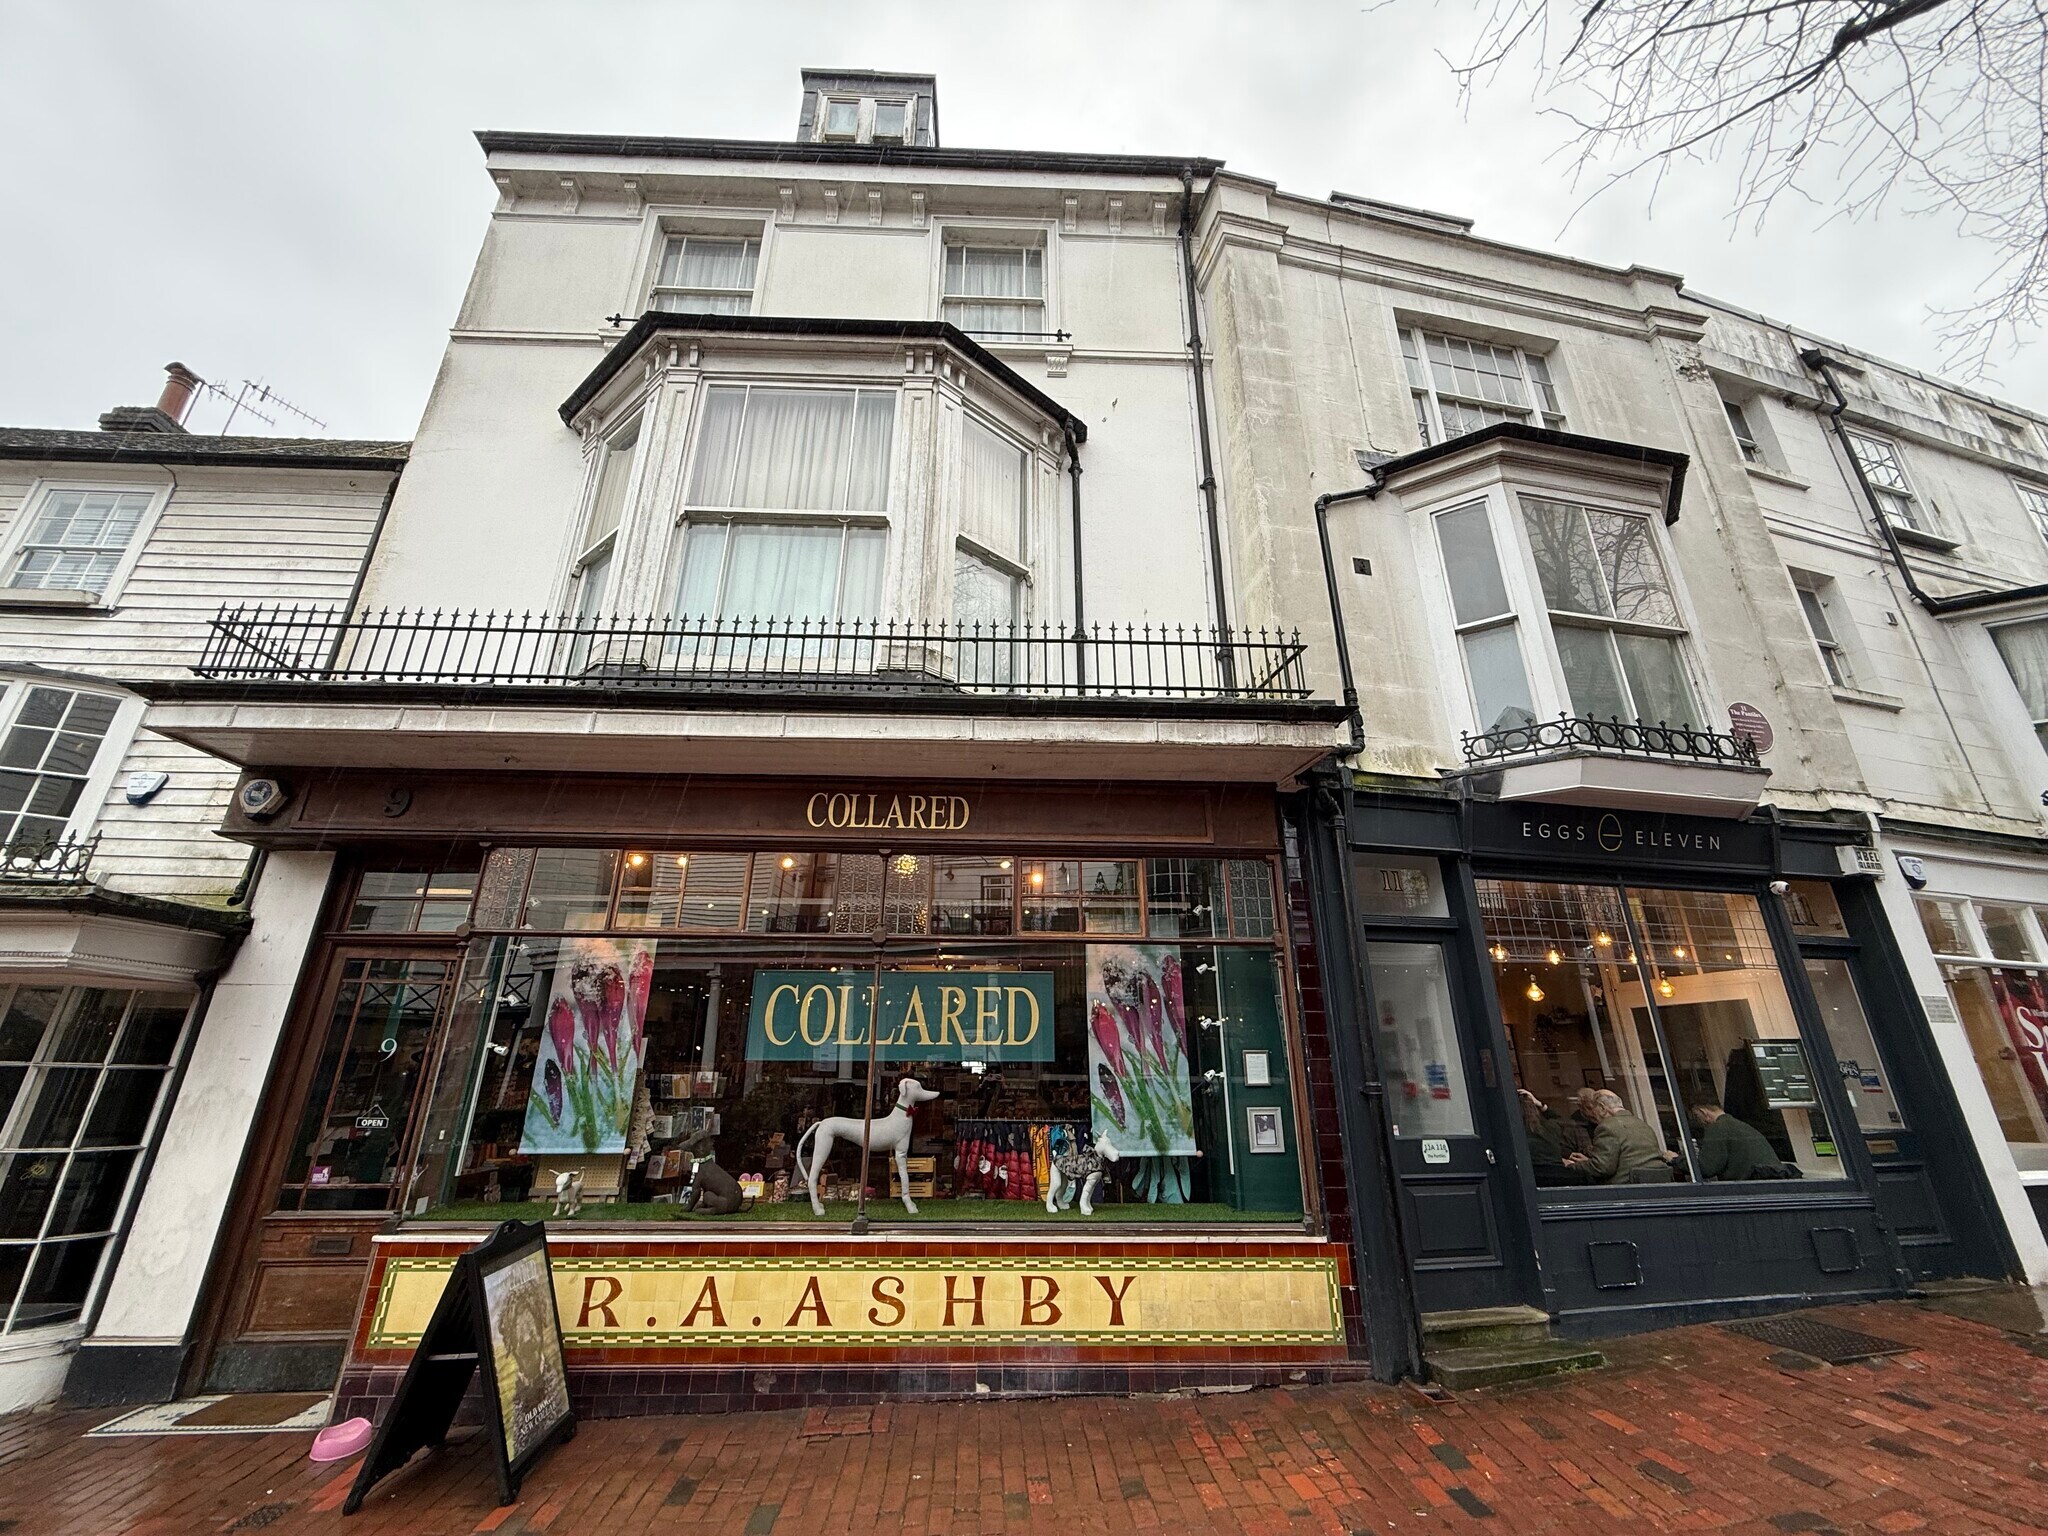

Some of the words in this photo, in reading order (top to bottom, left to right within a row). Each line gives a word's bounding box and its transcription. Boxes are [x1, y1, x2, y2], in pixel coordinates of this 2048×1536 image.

[383, 788, 411, 818] 9
[806, 792, 970, 830] COLLARED
[1523, 822, 1585, 841] EGGS
[1636, 830, 1720, 850] ELEVEN
[1856, 851, 1880, 862] ABEL
[1380, 869, 1403, 891] 11
[764, 984, 1040, 1046] COLLARED
[378, 1038, 398, 1062] 9
[361, 1118, 384, 1127] OPEN
